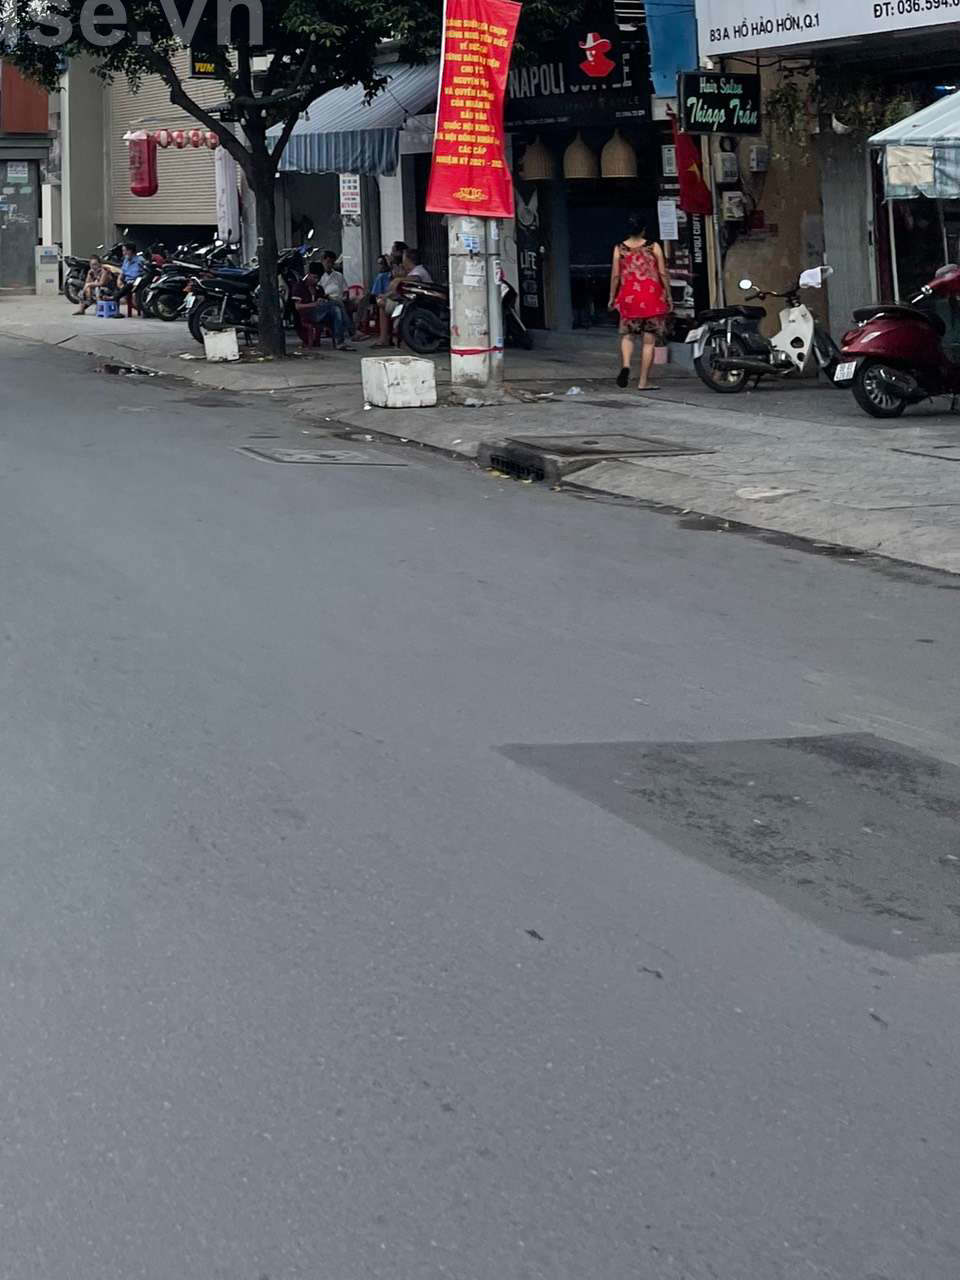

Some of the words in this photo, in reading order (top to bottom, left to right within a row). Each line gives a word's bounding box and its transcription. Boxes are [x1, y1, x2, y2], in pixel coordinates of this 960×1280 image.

[873, 2, 895, 18] ĐT:
[733, 17, 749, 39] HỒ
[751, 15, 773, 36] HẢO
[508, 62, 565, 99] NAPOLI
[699, 76, 718, 93] Hair
[686, 96, 726, 131] Thiago
